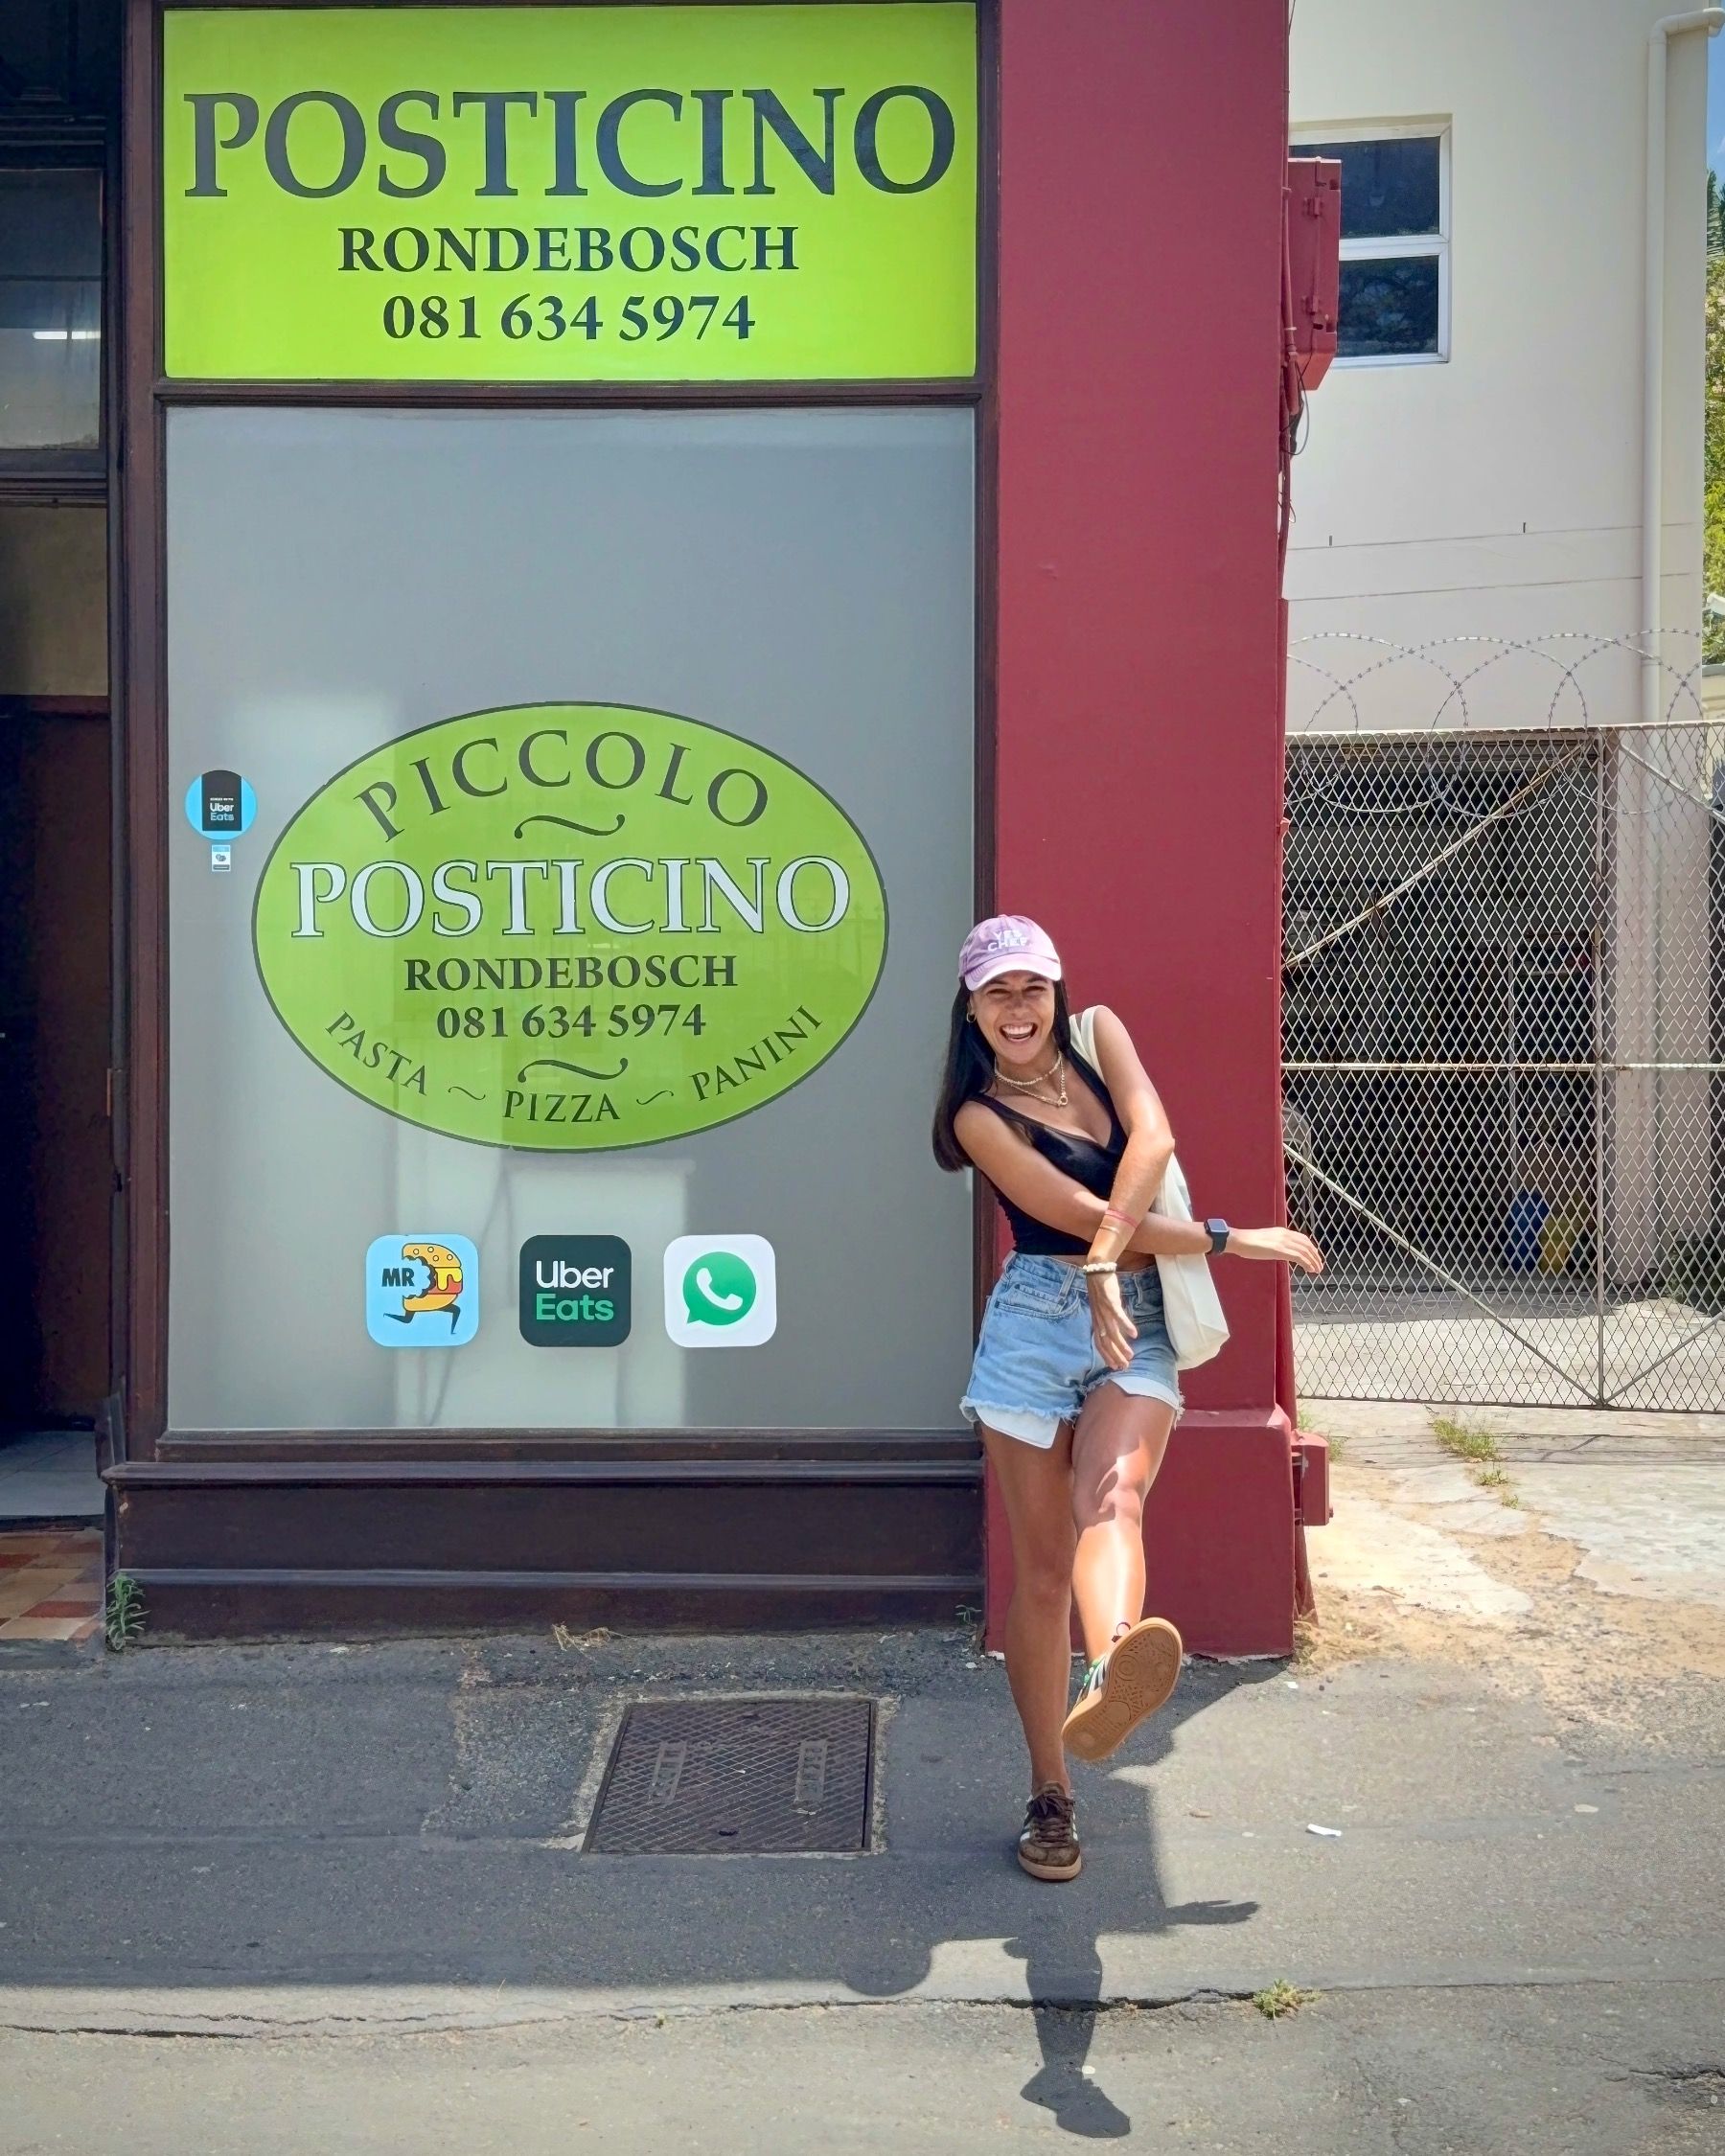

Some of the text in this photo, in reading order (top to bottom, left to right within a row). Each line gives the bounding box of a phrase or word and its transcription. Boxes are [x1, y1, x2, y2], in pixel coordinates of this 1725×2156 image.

[184, 85, 955, 198] POSTICINO
[337, 225, 799, 274] RONDEBOSCH
[383, 293, 756, 341] 081 634 5974
[353, 729, 769, 843] PICCOLO
[210, 803, 235, 813] Uber
[210, 813, 235, 821] Eats
[289, 855, 851, 938] POSTICINO
[404, 954, 738, 992] RONDEBOSCH
[436, 1002, 706, 1039] 081 634 5974
[324, 1004, 823, 1123] PASTA PIZZA PANINI
[536, 1260, 613, 1290] Uber
[536, 1293, 614, 1321] Eats
